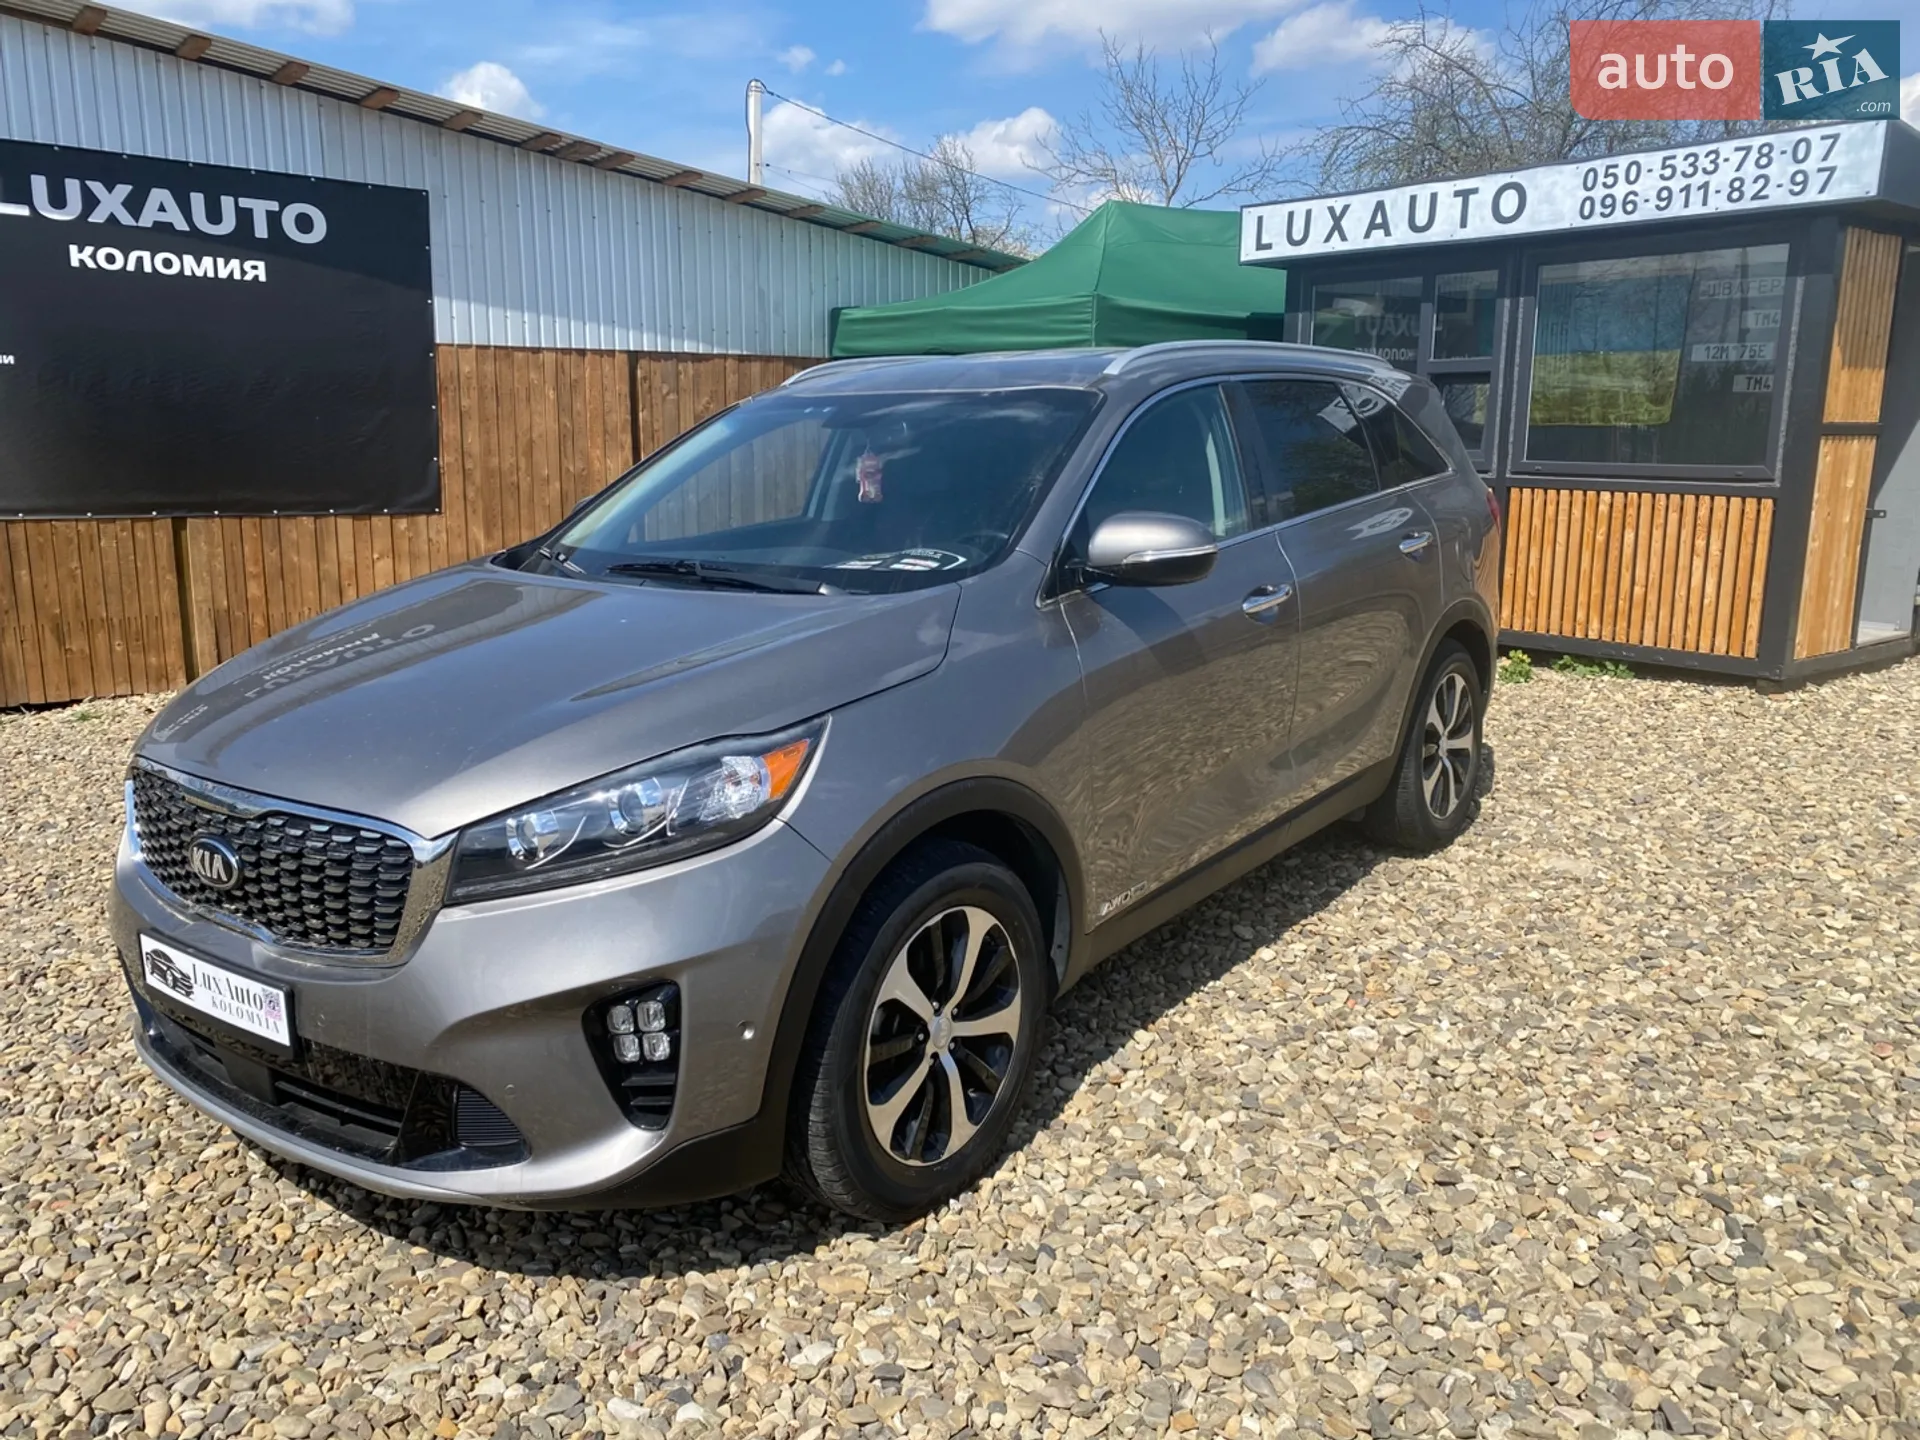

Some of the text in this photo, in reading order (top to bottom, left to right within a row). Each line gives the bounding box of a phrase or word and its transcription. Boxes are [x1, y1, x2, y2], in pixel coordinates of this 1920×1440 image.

[1583, 132, 1841, 192] 050-533-78-07
[1255, 181, 1527, 252] LUXAUTO
[1579, 165, 1838, 220] 096-911-82-97
[69, 244, 267, 283] КОЛОМИЯ
[193, 846, 228, 882] KIA
